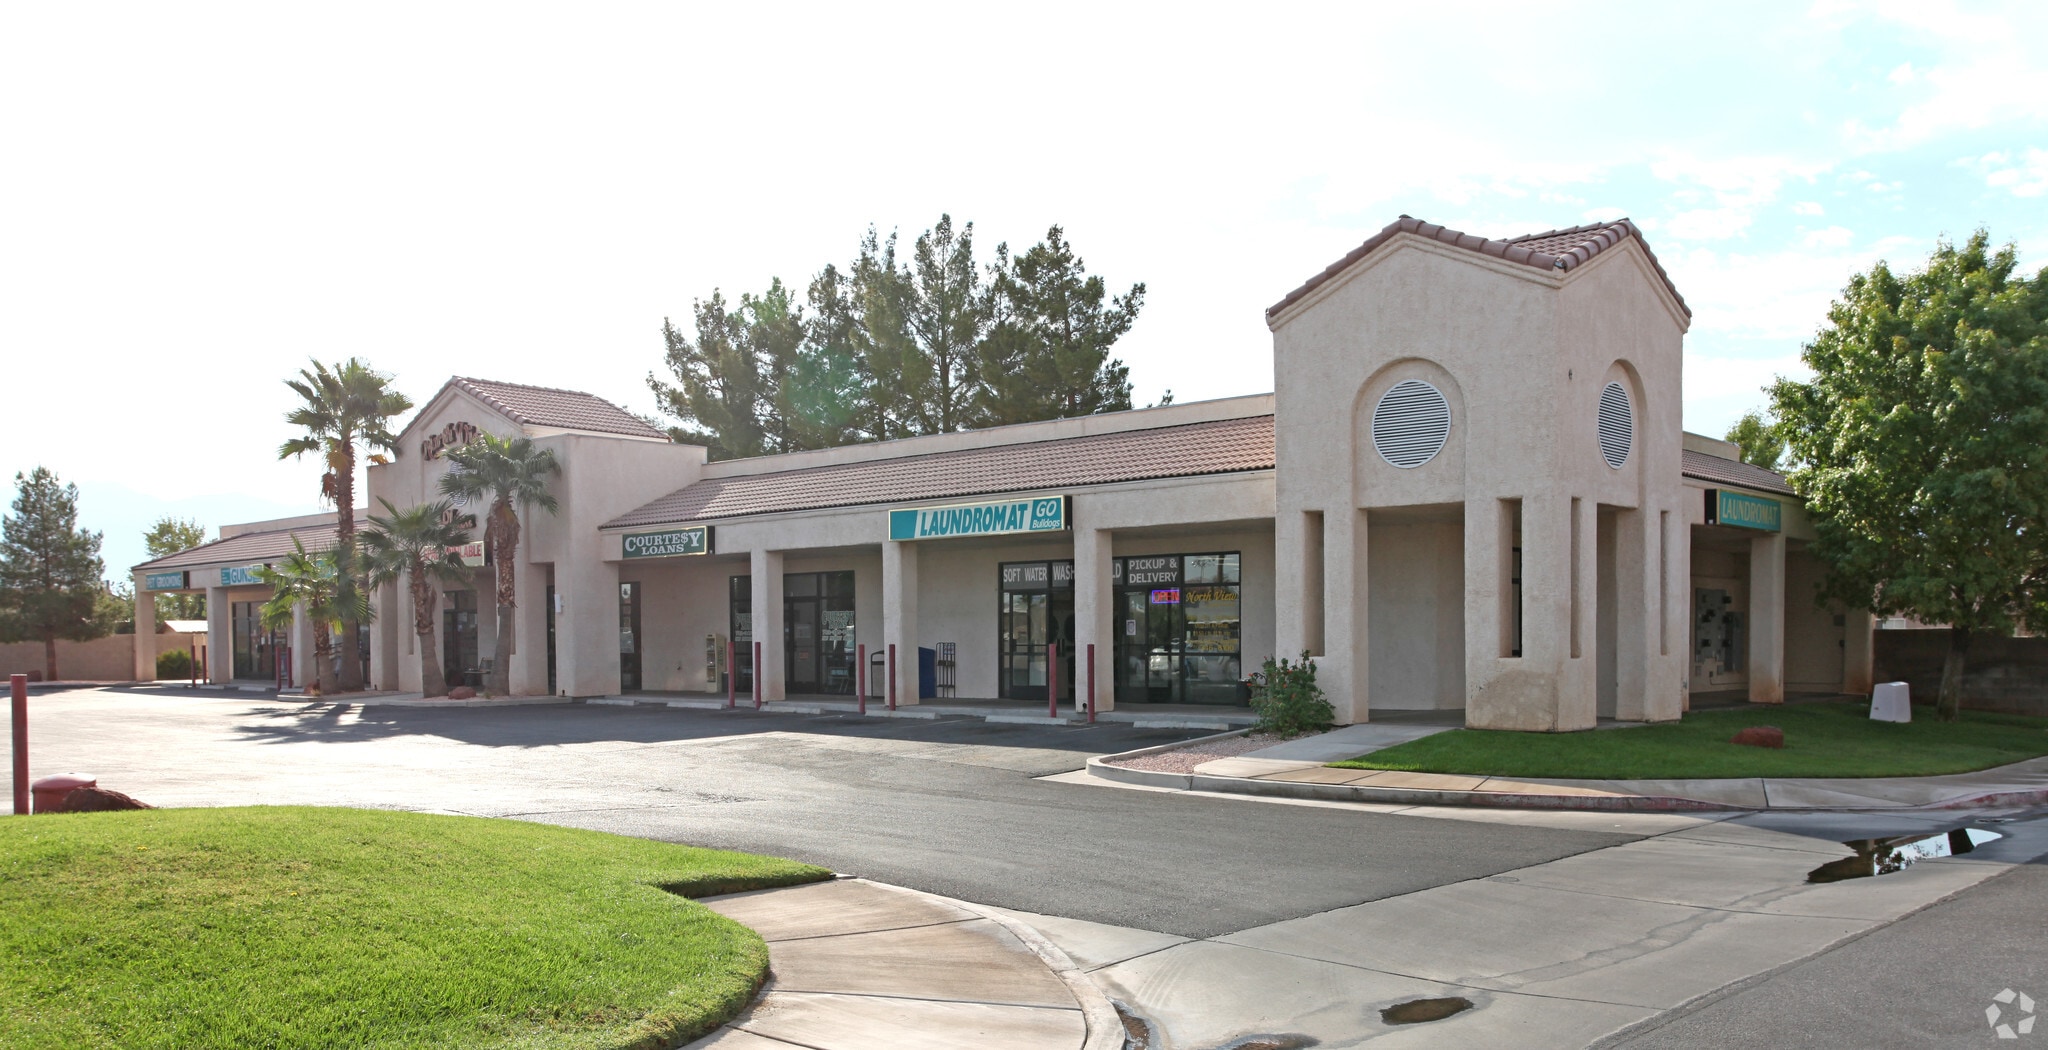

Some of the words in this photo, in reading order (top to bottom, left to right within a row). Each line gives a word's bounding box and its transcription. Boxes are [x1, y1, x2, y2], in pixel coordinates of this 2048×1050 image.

[1036, 500, 1057, 517] GO
[1722, 497, 1778, 526] LAUNDROMAT
[920, 503, 1028, 536] LAUNDROMAT
[1032, 518, 1060, 530] Bulldogs
[641, 543, 685, 555] LOANS
[1129, 559, 1165, 570] PICKUP
[1169, 558, 1178, 569] &
[231, 567, 253, 584] GUNS
[1003, 568, 1021, 582] SOFT
[1024, 567, 1047, 581] WATER
[1129, 571, 1178, 584] DELIVERY
[1153, 591, 1180, 602] OPEN
[1186, 590, 1212, 604] North
[1213, 590, 1238, 601] View
